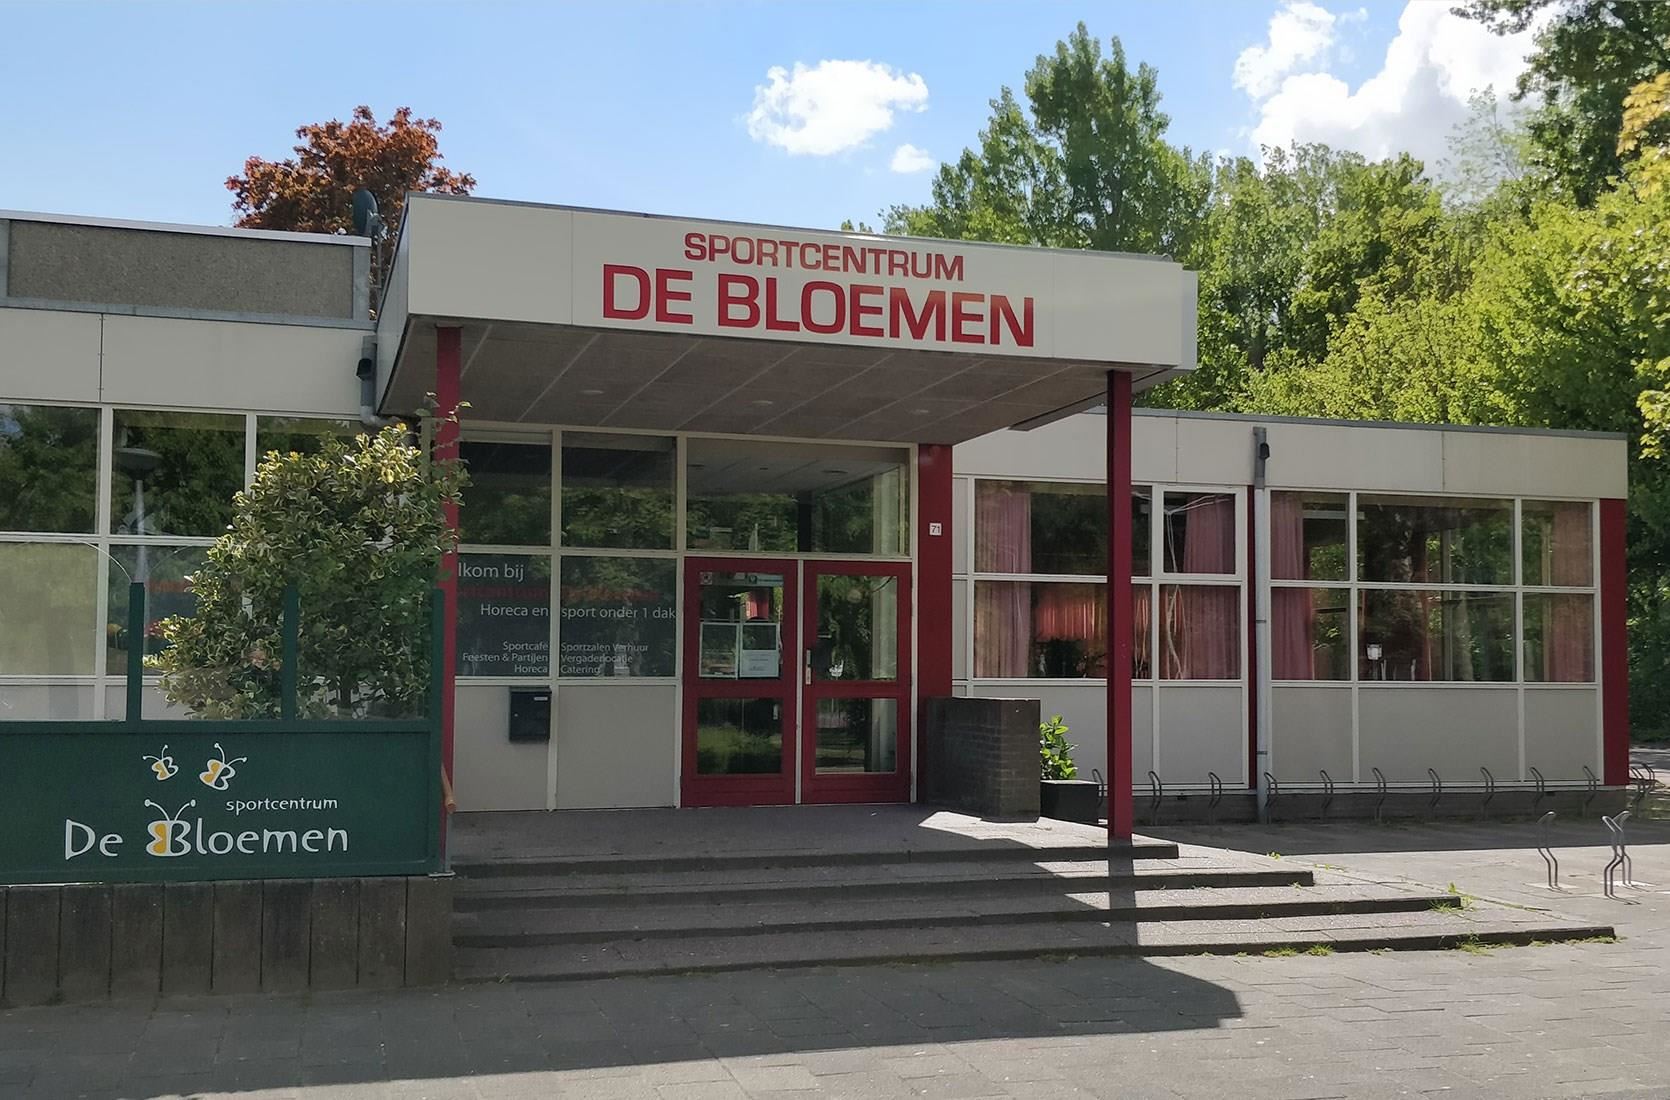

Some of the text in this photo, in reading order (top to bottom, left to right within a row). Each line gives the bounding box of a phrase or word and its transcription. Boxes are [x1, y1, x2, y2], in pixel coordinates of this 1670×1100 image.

[684, 232, 964, 281] SPORTCENTRUM
[603, 264, 1034, 347] DE BLOEMEN
[931, 525, 940, 534] 71
[458, 562, 524, 582] lkom bij
[480, 603, 528, 616] Horeca
[531, 607, 549, 616] en
[561, 607, 597, 620] sport
[599, 606, 638, 618] onder
[652, 606, 676, 619] dak
[462, 652, 500, 662] Feesten
[502, 653, 509, 662] &
[514, 665, 601, 677] Horeca Catering
[225, 797, 338, 815] sportcentrum
[65, 818, 349, 860] De Bloemen
